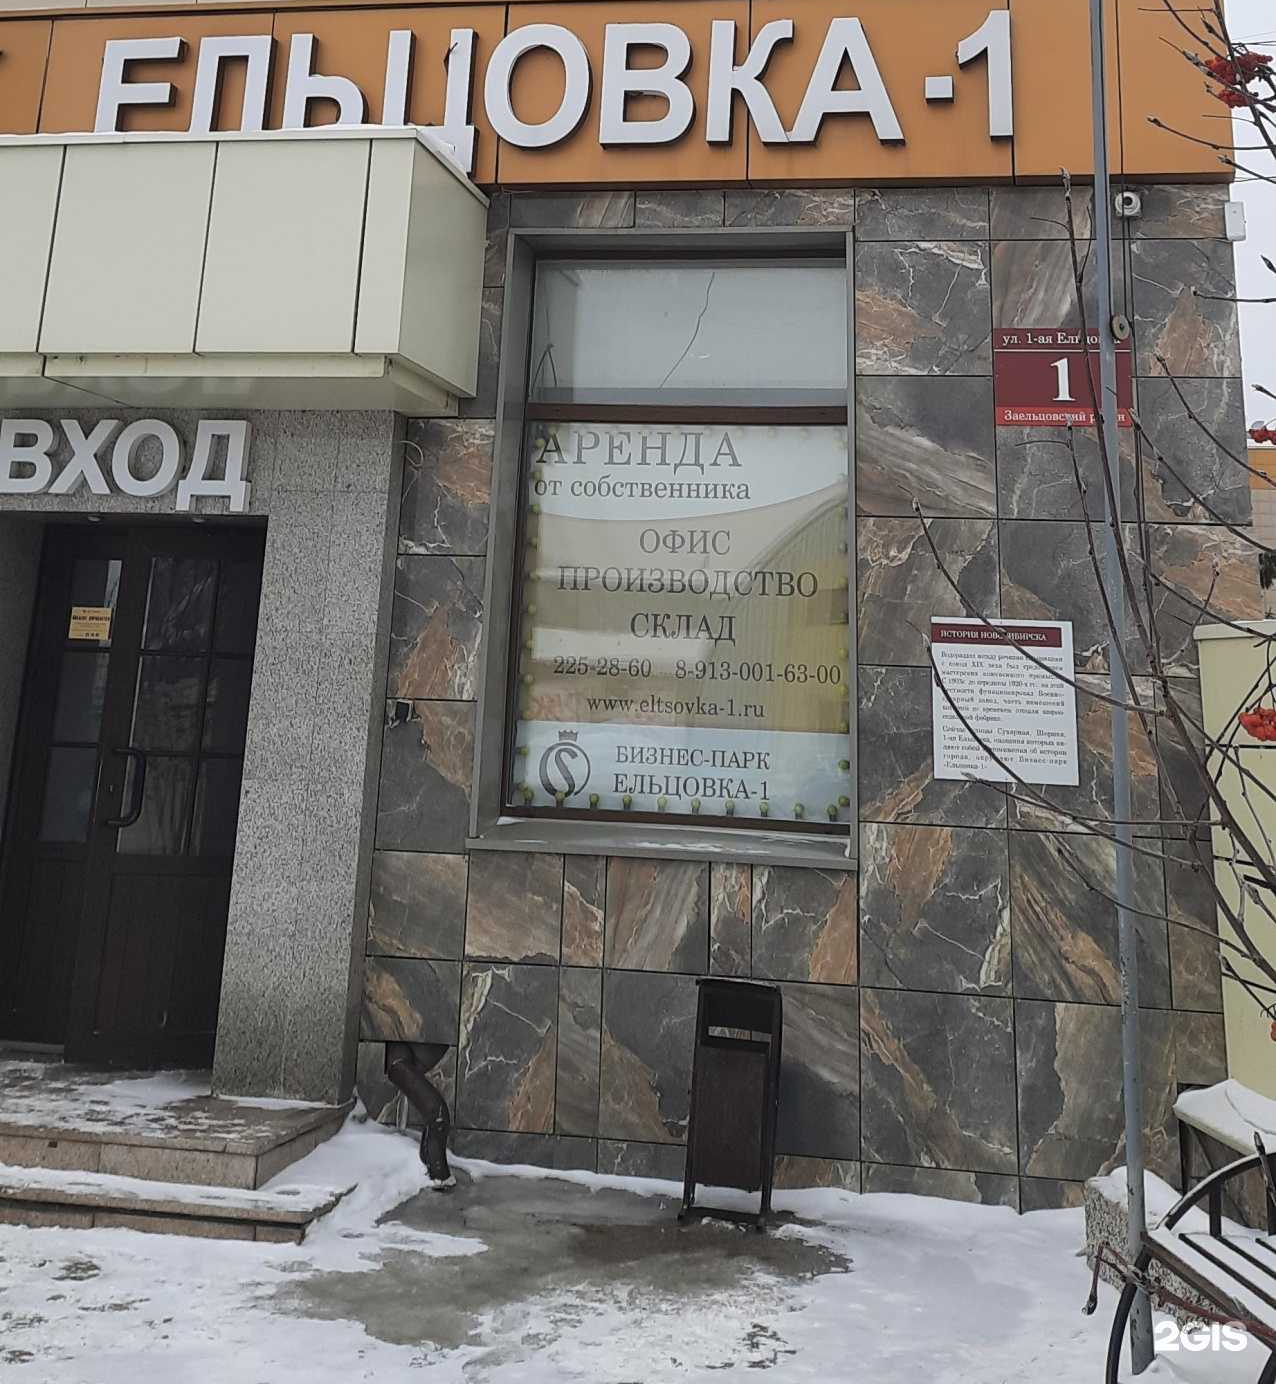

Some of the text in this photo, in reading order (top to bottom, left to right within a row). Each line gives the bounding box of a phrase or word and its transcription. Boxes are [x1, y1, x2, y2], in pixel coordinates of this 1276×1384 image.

[1002, 335, 1021, 346] ул.
[1027, 333, 1053, 345] 1-ая
[1050, 357, 1076, 402] 1
[0, 418, 252, 512] ВХОД
[536, 431, 743, 477] АРЕНДА
[534, 474, 751, 500] от собственника
[639, 528, 731, 555] ОФИС
[557, 566, 818, 600] ПРОИЗВОДСТВО
[630, 613, 736, 648] СКЛАД
[940, 629, 979, 640] ИСТОРИЯ
[553, 655, 841, 685] 225-28-60 8-913-001-63-00
[586, 694, 766, 718] www.eltsovka-1.ru
[615, 745, 771, 770] БИЗНЕС-ПАРК
[612, 772, 771, 802] ЕЛЬЦОВКА-1
